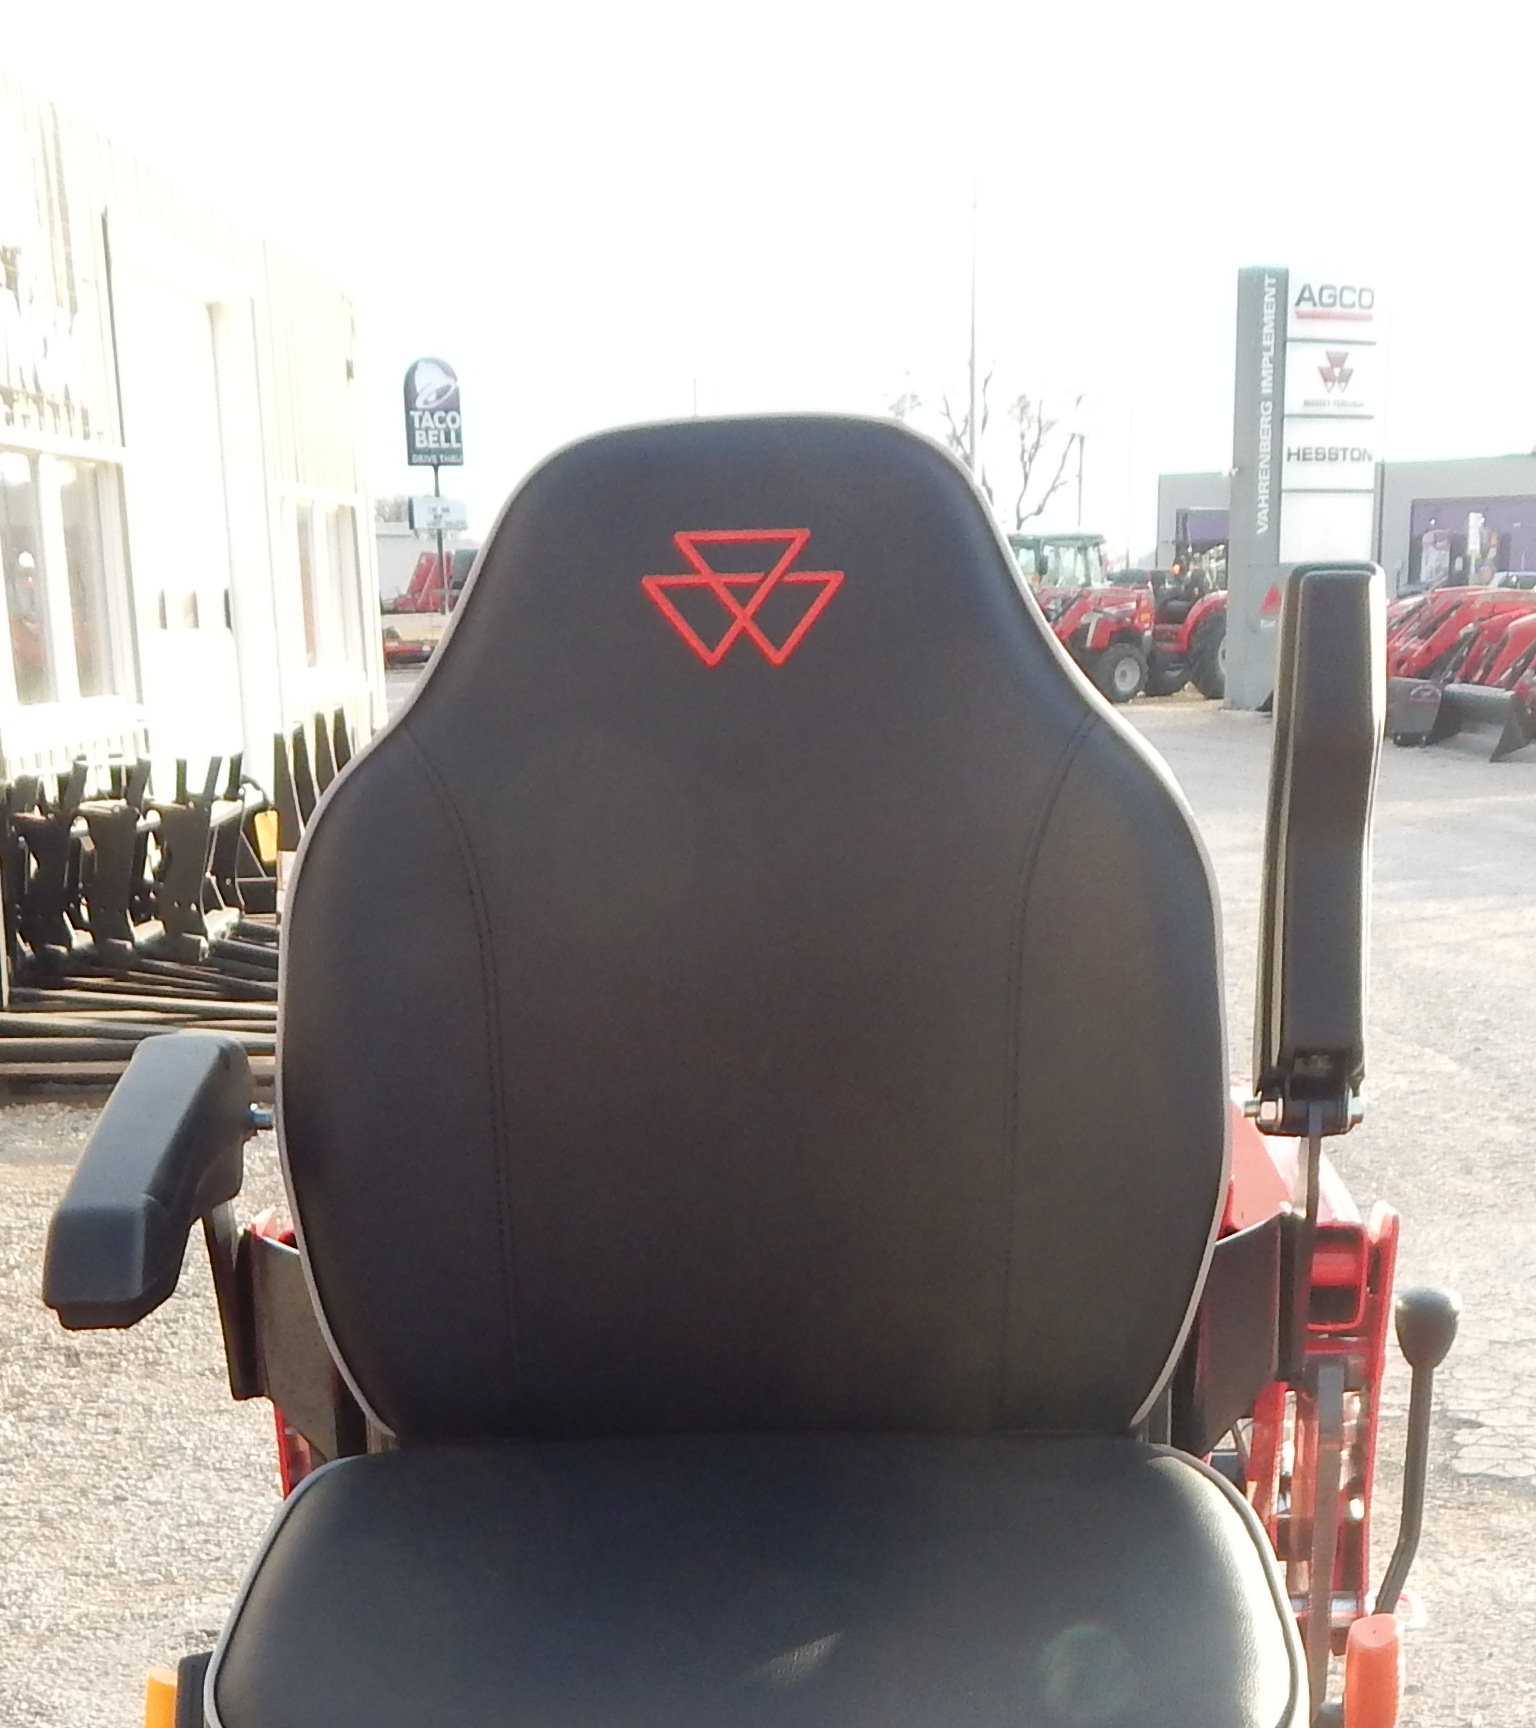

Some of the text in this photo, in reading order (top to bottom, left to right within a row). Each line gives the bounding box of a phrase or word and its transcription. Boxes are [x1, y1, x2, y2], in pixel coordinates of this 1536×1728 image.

[1294, 283, 1375, 310] AGCO
[1256, 273, 1278, 535] VAHRENBERG IMPLEMENT
[409, 410, 461, 429] TACO
[415, 429, 461, 448] BELL
[1286, 446, 1374, 463] HESSTON
